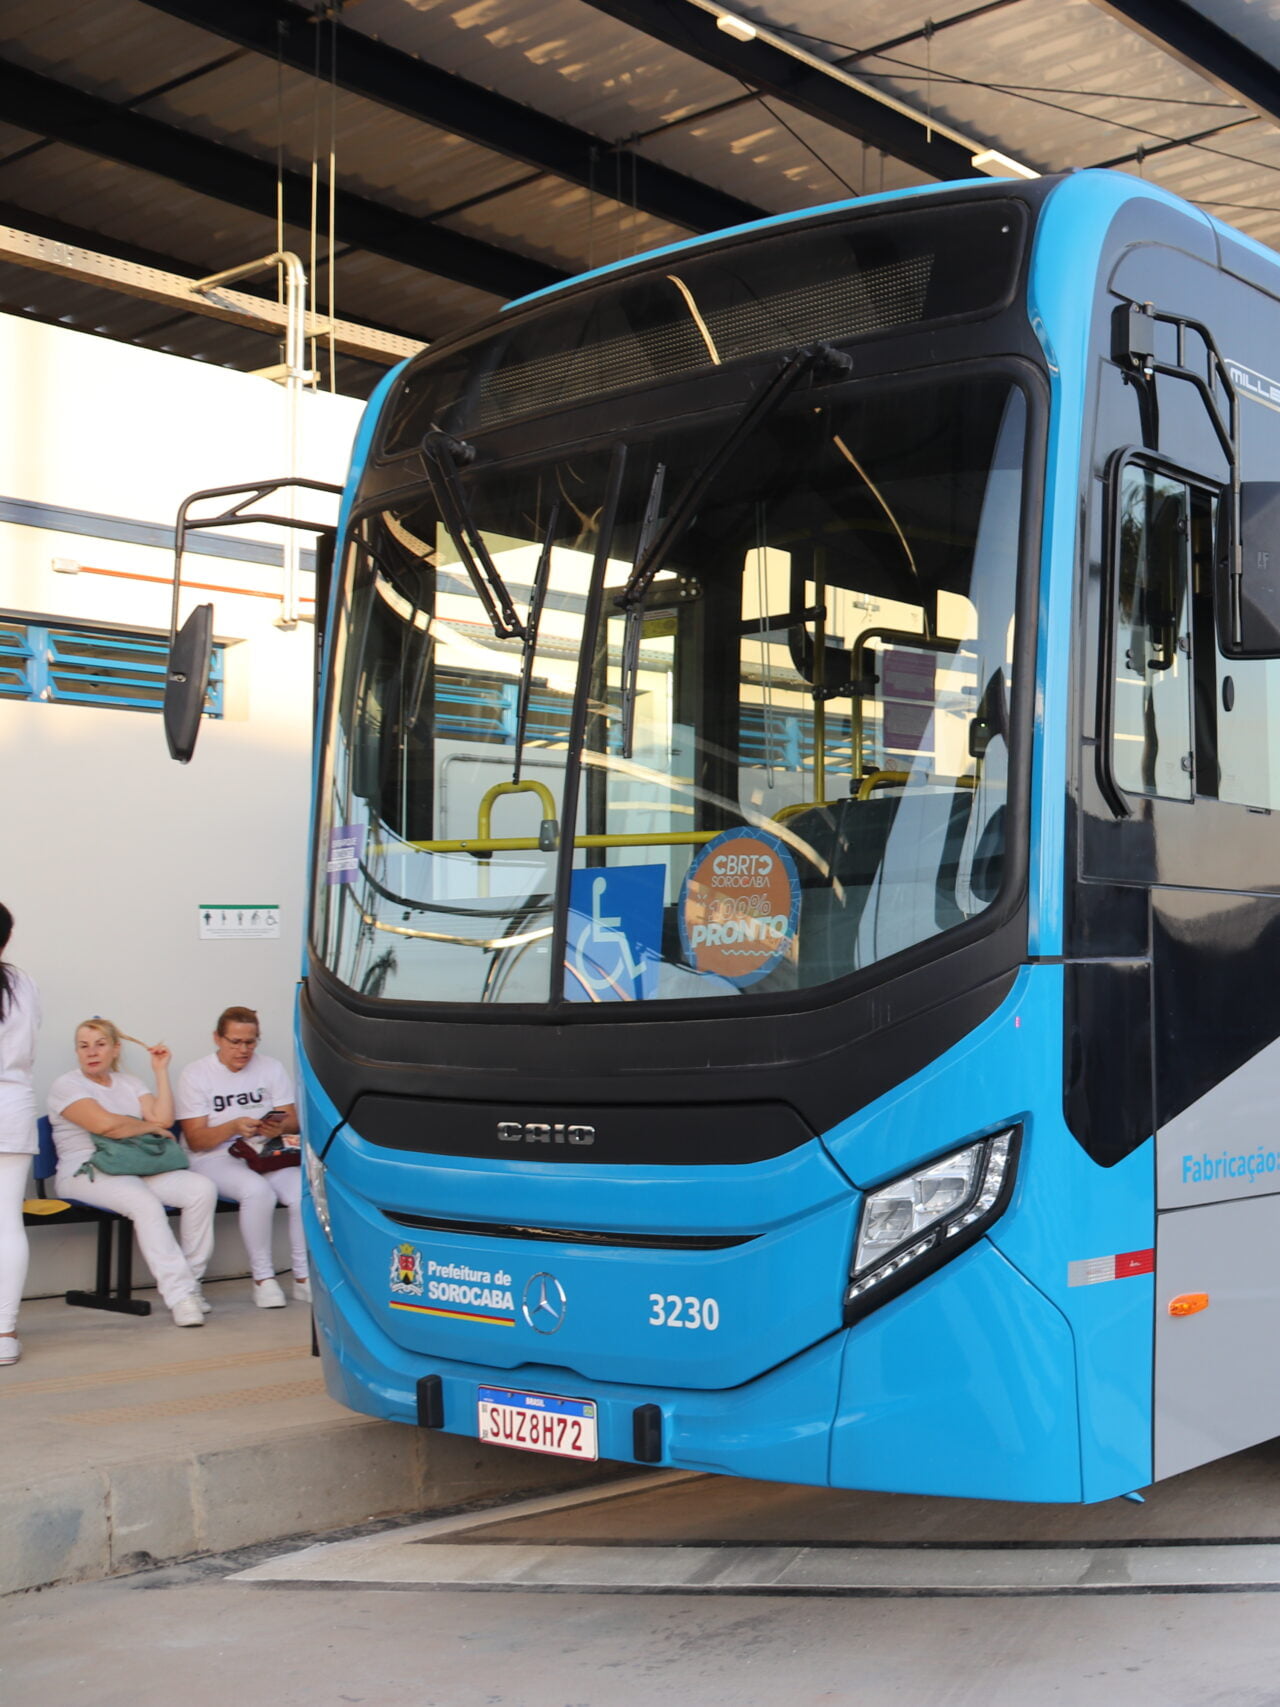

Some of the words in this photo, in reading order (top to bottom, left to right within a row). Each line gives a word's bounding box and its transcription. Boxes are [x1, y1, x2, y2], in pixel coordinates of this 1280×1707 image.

[711, 876, 770, 888] SOROCABA
[707, 893, 771, 922] 100%
[691, 914, 789, 948] PRONTO
[213, 1091, 263, 1112] grau
[497, 1122, 595, 1145] CAIO
[1182, 1146, 1280, 1184] Fabricação:
[428, 1261, 491, 1284] Prefeitura
[494, 1270, 512, 1286] de
[428, 1282, 515, 1310] SOROCABA
[649, 1294, 719, 1331] 3230
[490, 1407, 583, 1451] SUZ8H72
